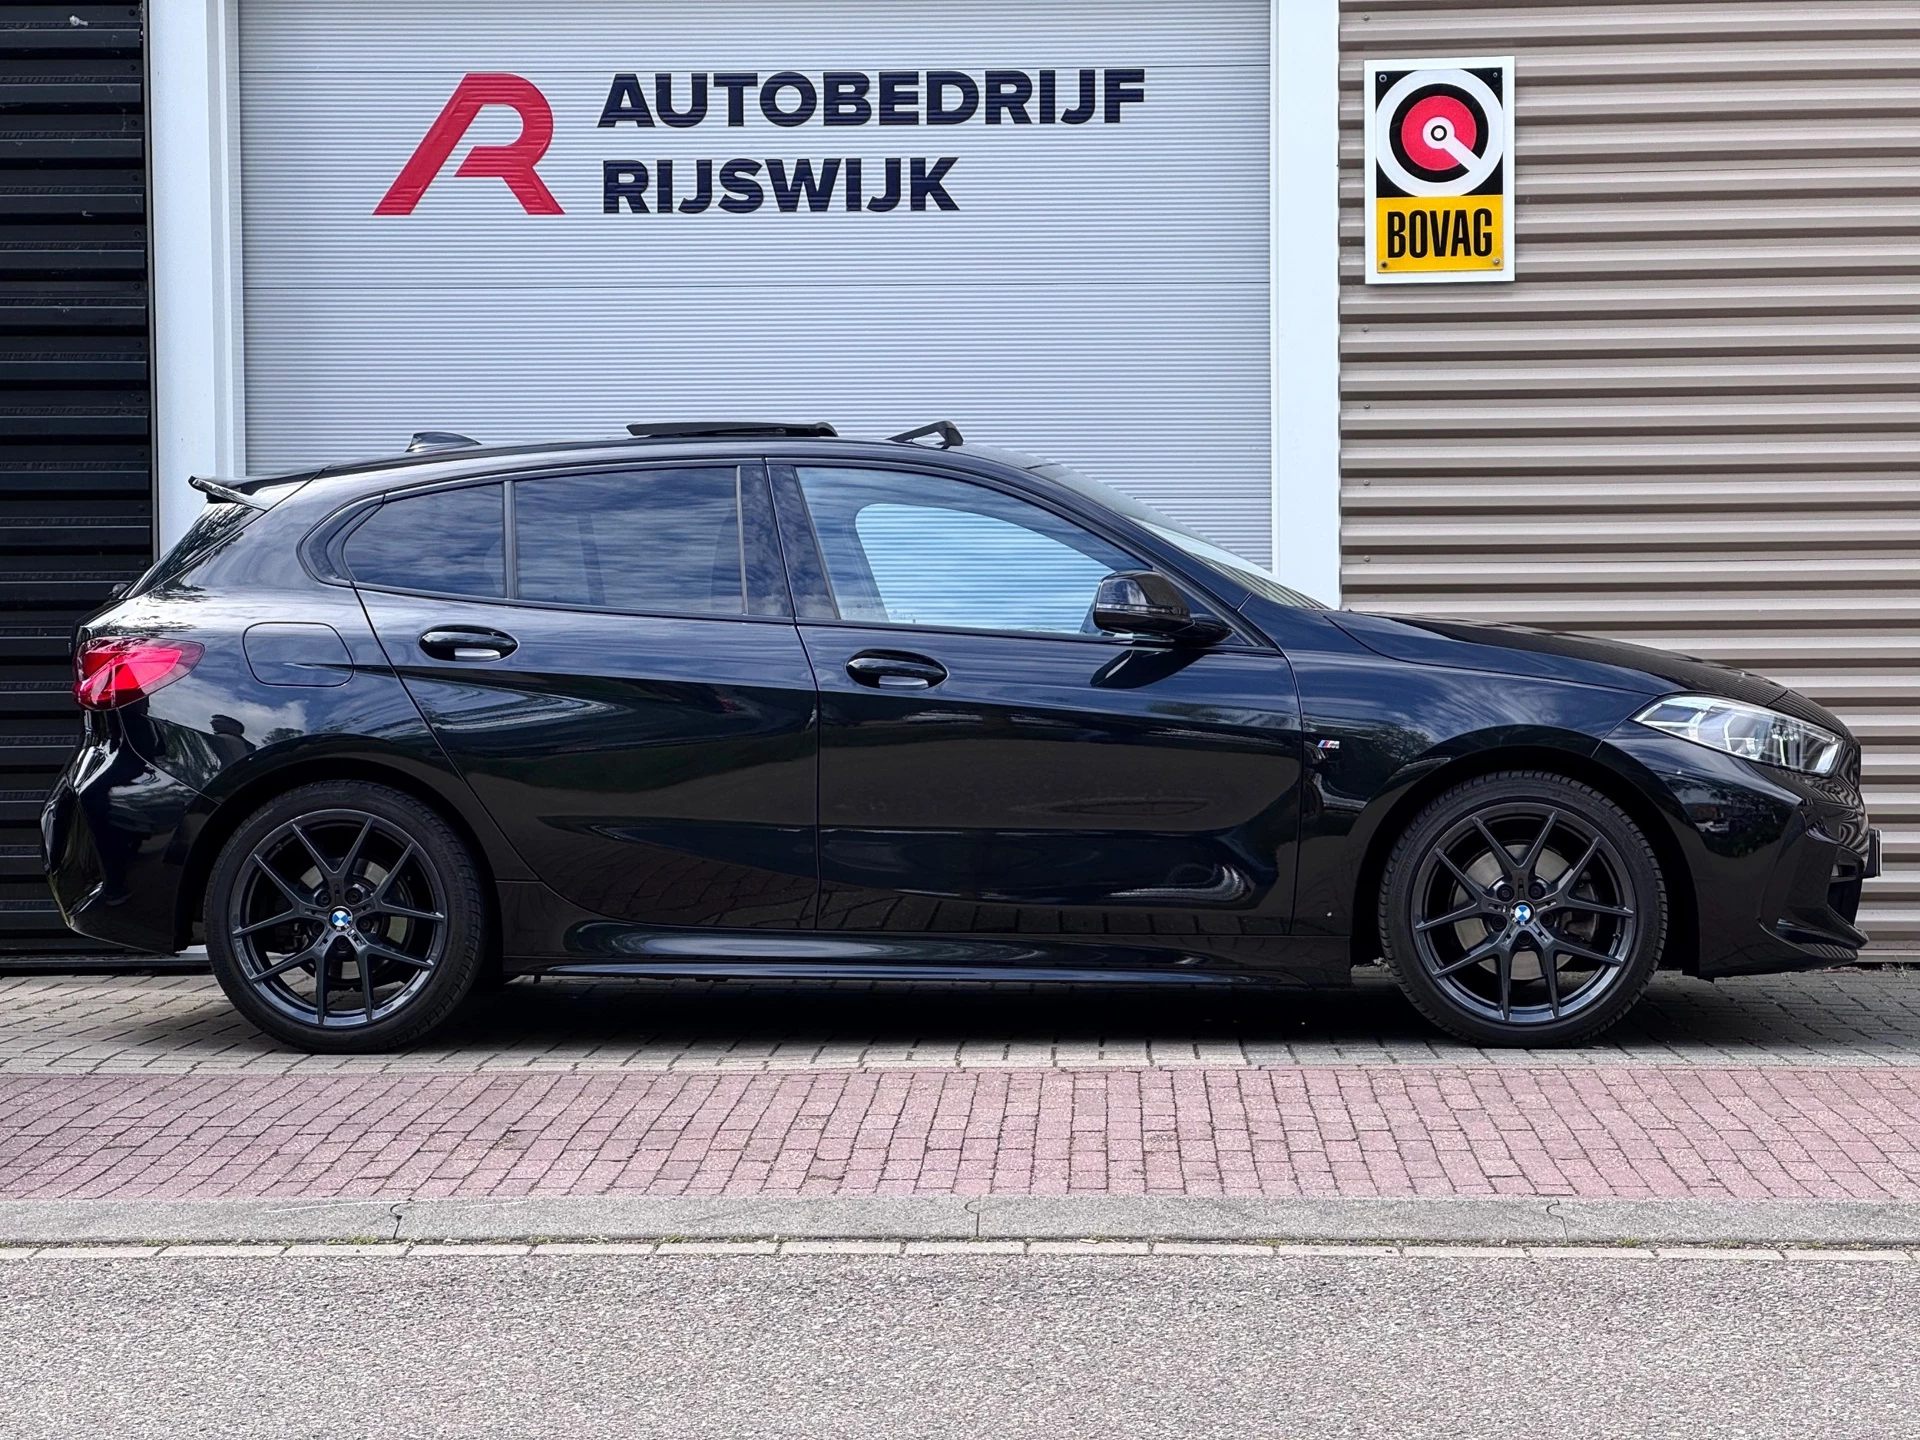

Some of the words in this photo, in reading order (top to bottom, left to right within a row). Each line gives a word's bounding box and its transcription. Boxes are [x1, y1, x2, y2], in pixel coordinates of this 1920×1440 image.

[597, 69, 1145, 128] AUTOBEDRIJF
[603, 157, 960, 214] RIJSWIJK
[1387, 208, 1493, 259] BOVAG
